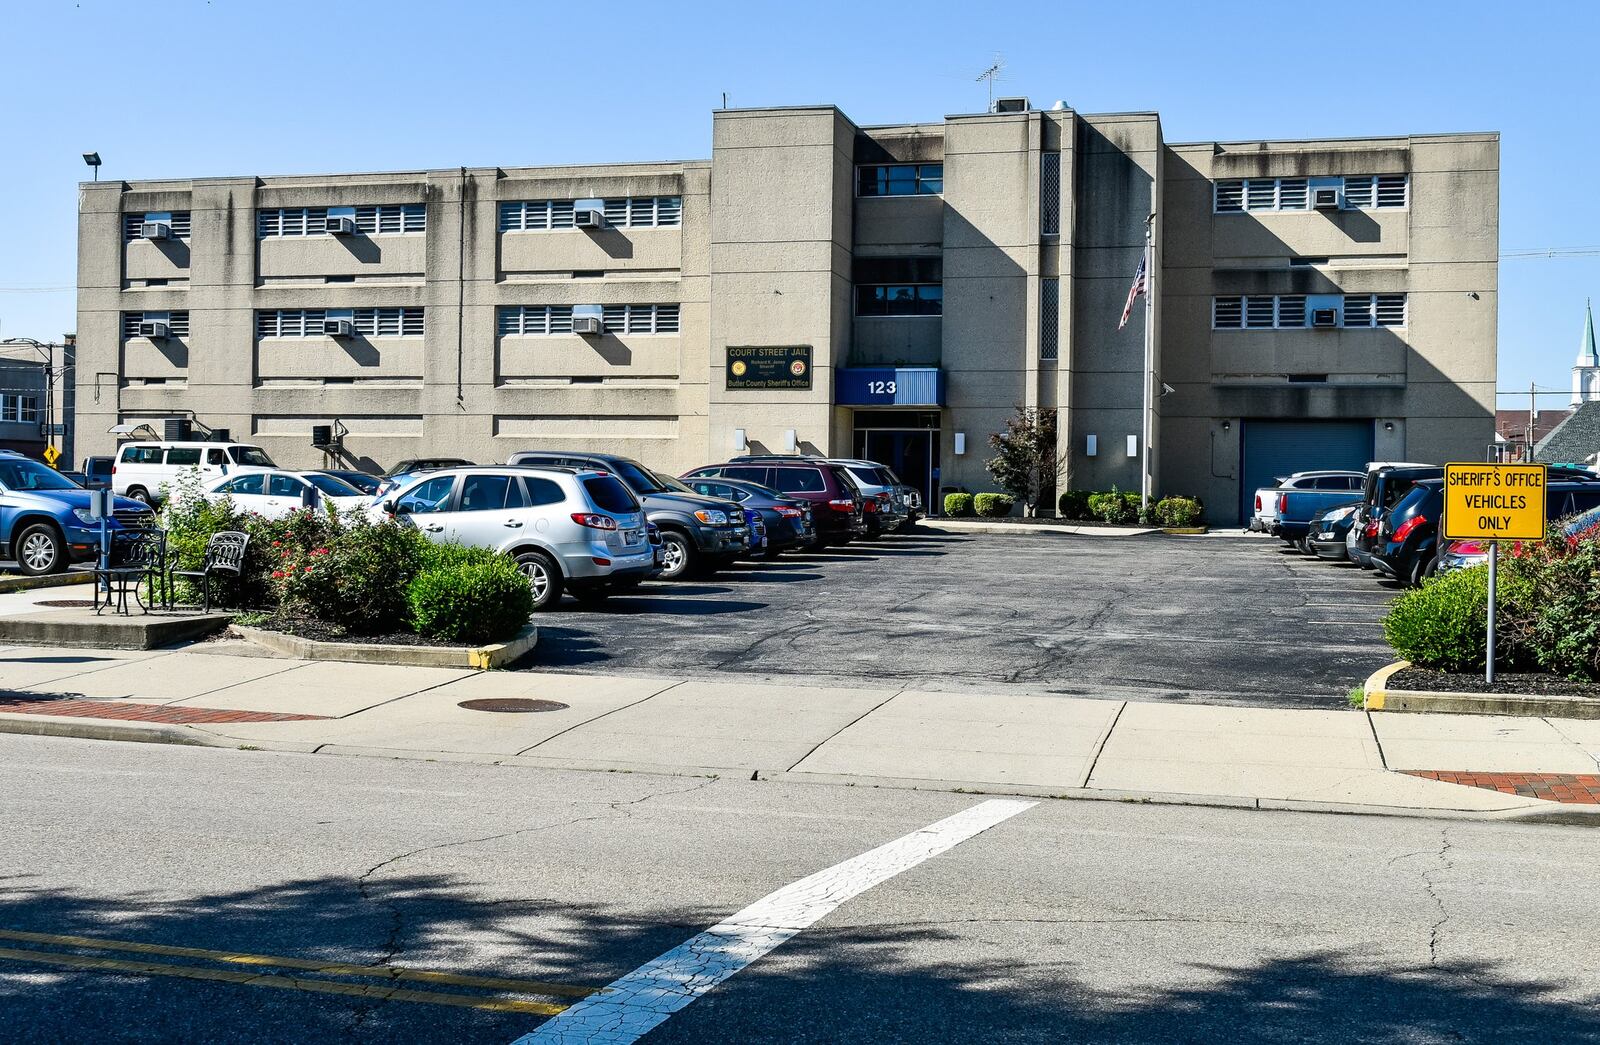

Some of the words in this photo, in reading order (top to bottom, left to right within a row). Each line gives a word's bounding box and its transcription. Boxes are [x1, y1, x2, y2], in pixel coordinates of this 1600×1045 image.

[729, 348, 757, 357] COURT
[758, 348, 788, 357] STREET
[791, 348, 808, 356] JAIL
[745, 380, 766, 388] County
[868, 381, 897, 394] 123
[1449, 470, 1501, 486] SHERIFF'S
[1505, 473, 1542, 487] OFFICE
[1464, 495, 1526, 509] VEHICLES
[1478, 515, 1511, 530] ONLY
